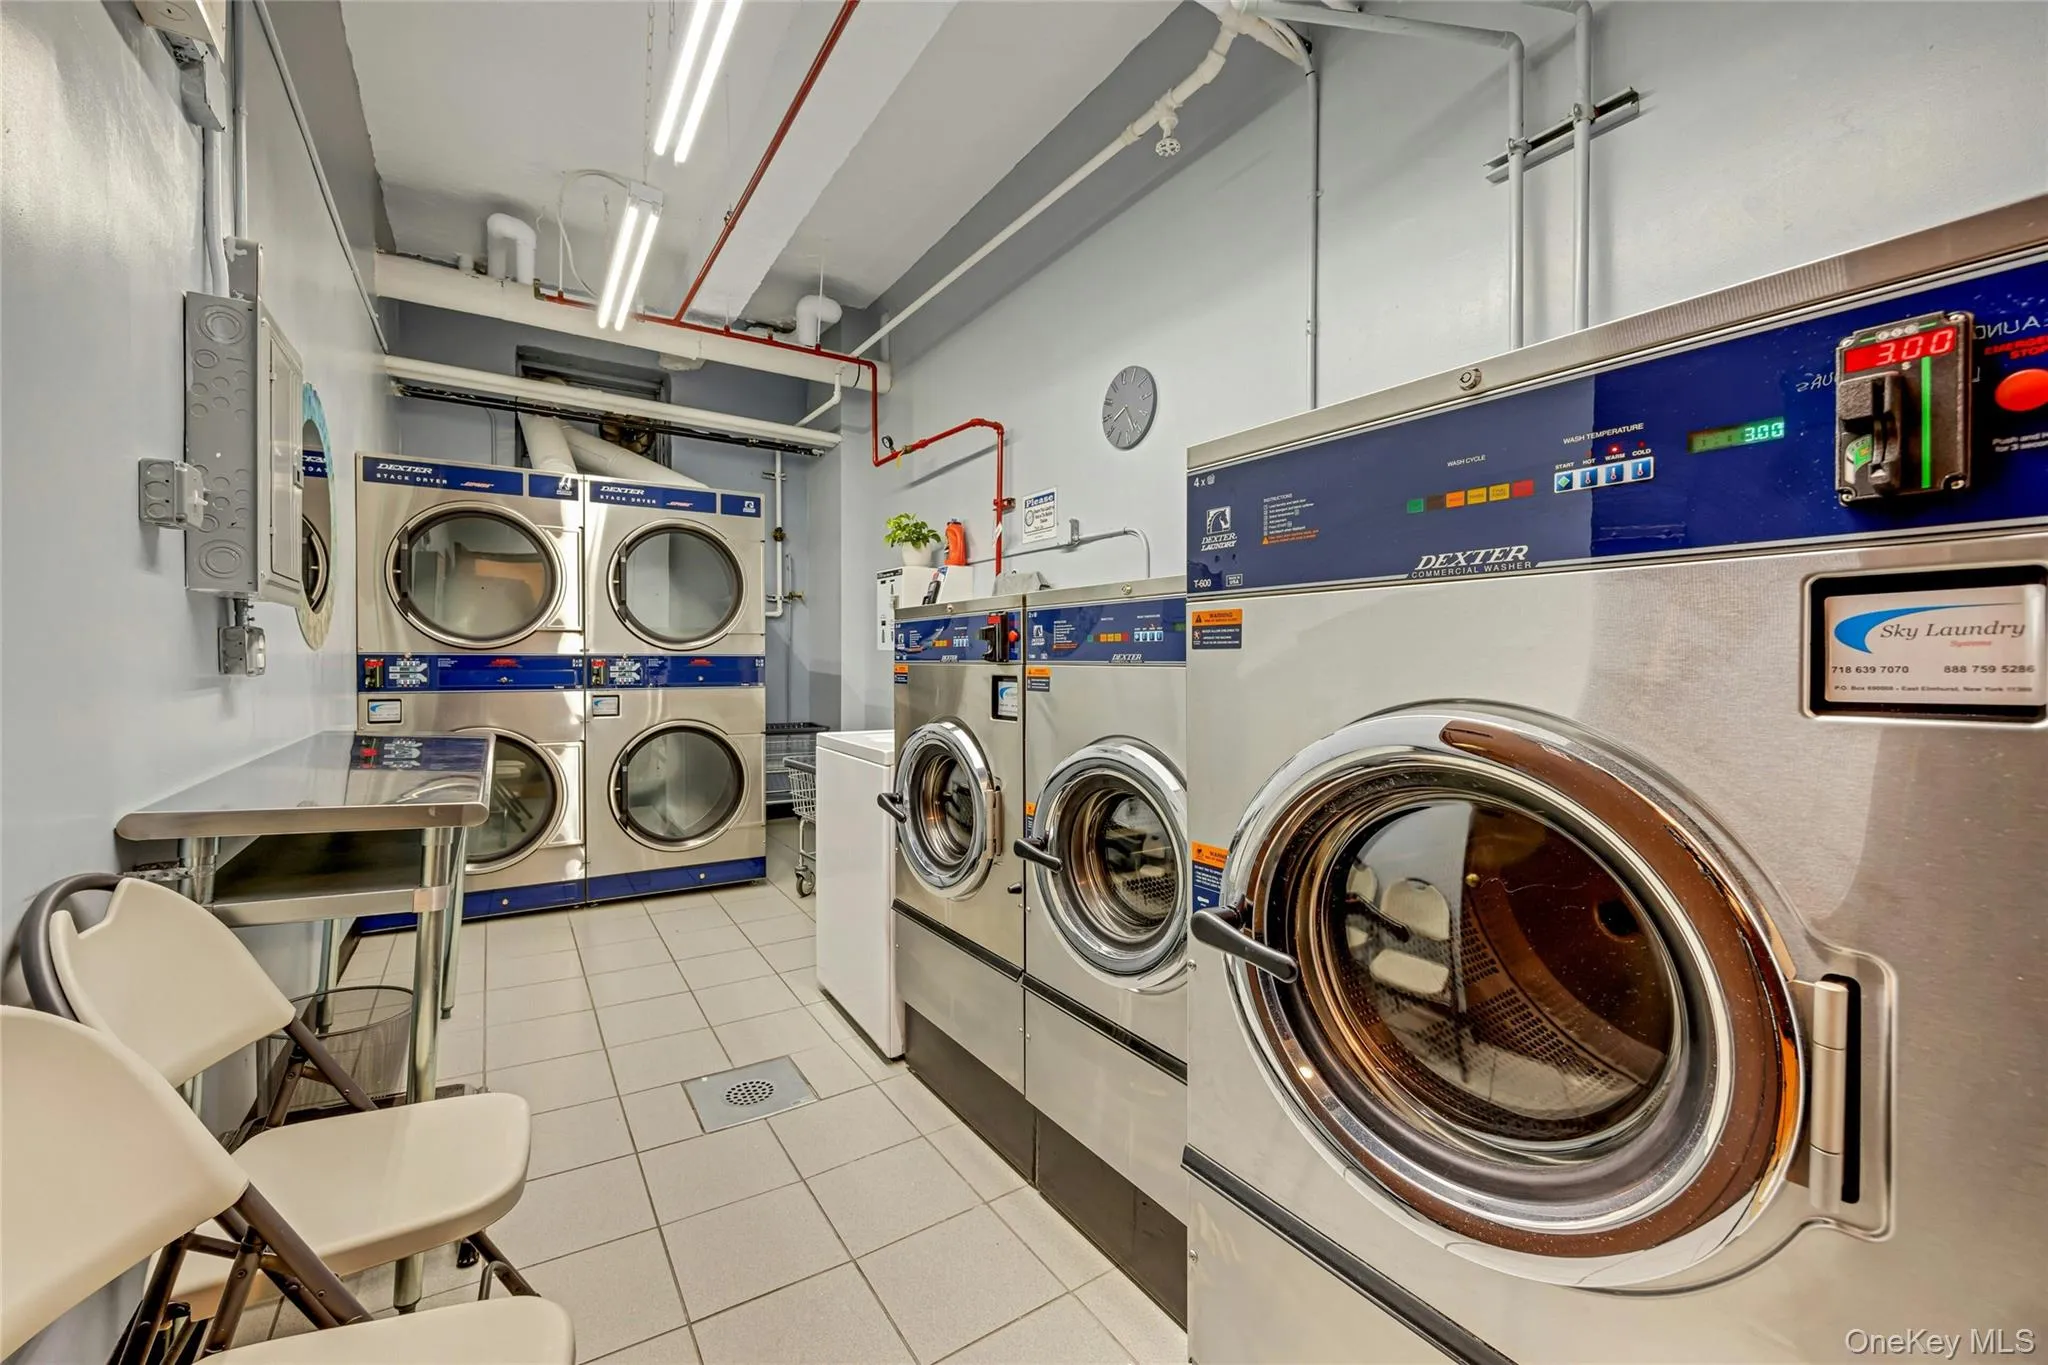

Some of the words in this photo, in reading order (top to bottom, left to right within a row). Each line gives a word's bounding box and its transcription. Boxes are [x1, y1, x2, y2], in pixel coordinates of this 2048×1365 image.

[1876, 330, 1954, 366] 3.00
[1563, 433, 1585, 445] WASH
[1586, 422, 1645, 440] TEMPERATURE
[1744, 421, 1785, 442] 3.00
[1604, 452, 1626, 461] WARM
[1631, 448, 1652, 457] COLD
[1447, 458, 1465, 468] WASH
[1465, 454, 1487, 464] CYCLE
[1554, 461, 1575, 471] START
[1582, 457, 1596, 465] HOT
[376, 463, 433, 474] DEXTER
[376, 473, 410, 481] STACK
[416, 476, 448, 485] DRYER
[1193, 477, 1200, 487] 4
[600, 485, 645, 496] DEXTER
[1026, 494, 1054, 507] Please
[1201, 532, 1237, 545] DEXTER
[1200, 540, 1238, 552] LAUNDRY
[1414, 544, 1529, 571] DEXTER
[1411, 566, 1480, 579] COMMERCIAL
[1484, 561, 1532, 573] WASHER
[1193, 578, 1212, 589] T-600
[1880, 623, 1919, 641] Sky
[1925, 620, 2026, 638] Laundry
[1831, 665, 1852, 674] 718
[1855, 665, 1877, 674] 639
[1880, 665, 1909, 674] 7070
[1943, 665, 1967, 674] 888
[1972, 665, 1997, 674] 759
[2001, 664, 2036, 674] 5286
